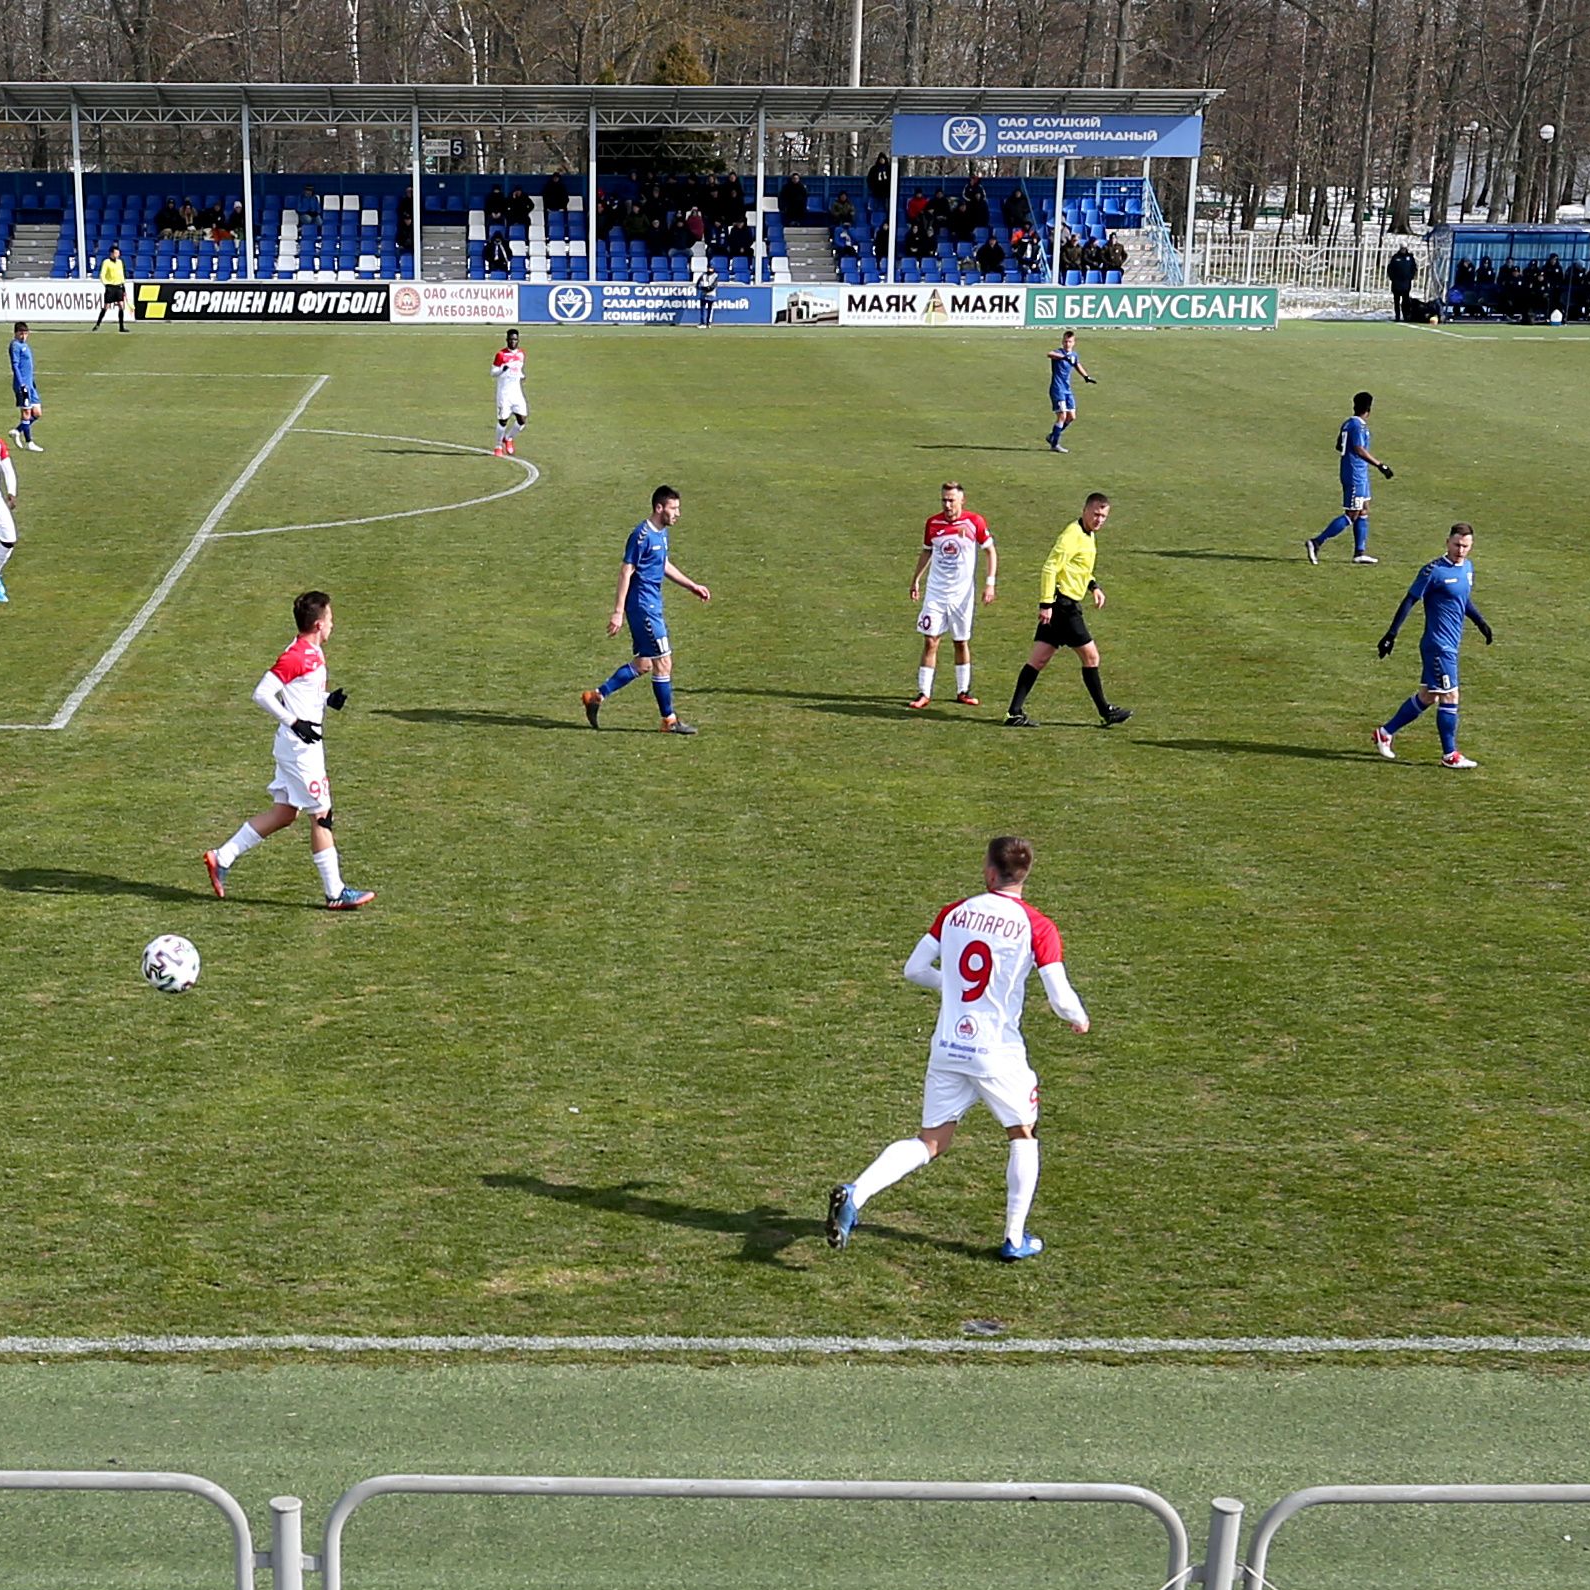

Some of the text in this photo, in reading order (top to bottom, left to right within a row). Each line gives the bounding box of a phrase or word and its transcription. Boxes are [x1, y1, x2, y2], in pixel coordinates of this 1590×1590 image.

[997, 116, 1102, 129] ОАО СЛУЦКИЙ
[997, 129, 1158, 142] САХАРОРАФИНАДНЫЙ
[453, 141, 462, 155] 5
[997, 144, 1077, 154] КОМБИНАТ
[423, 285, 514, 301] ОАО «СЛУЦКИЙ
[603, 285, 697, 298] ОАО СЛУЦКИЙ
[16, 292, 126, 310] МЯСОКОМБИ
[171, 291, 386, 315] ЗАРЯЖЕН НА ФУТБОЛ!
[603, 297, 749, 310] САХАРОРАФИНДНЫЙ
[847, 294, 918, 313] МАЯК
[951, 294, 1021, 313] МАЯК
[1063, 294, 1268, 321] БЕЛАРУСБАНК
[428, 304, 514, 318] ХЛЕБОЗАВОД»
[603, 311, 676, 321] КОМБИНАТ
[958, 940, 993, 1003] 9
